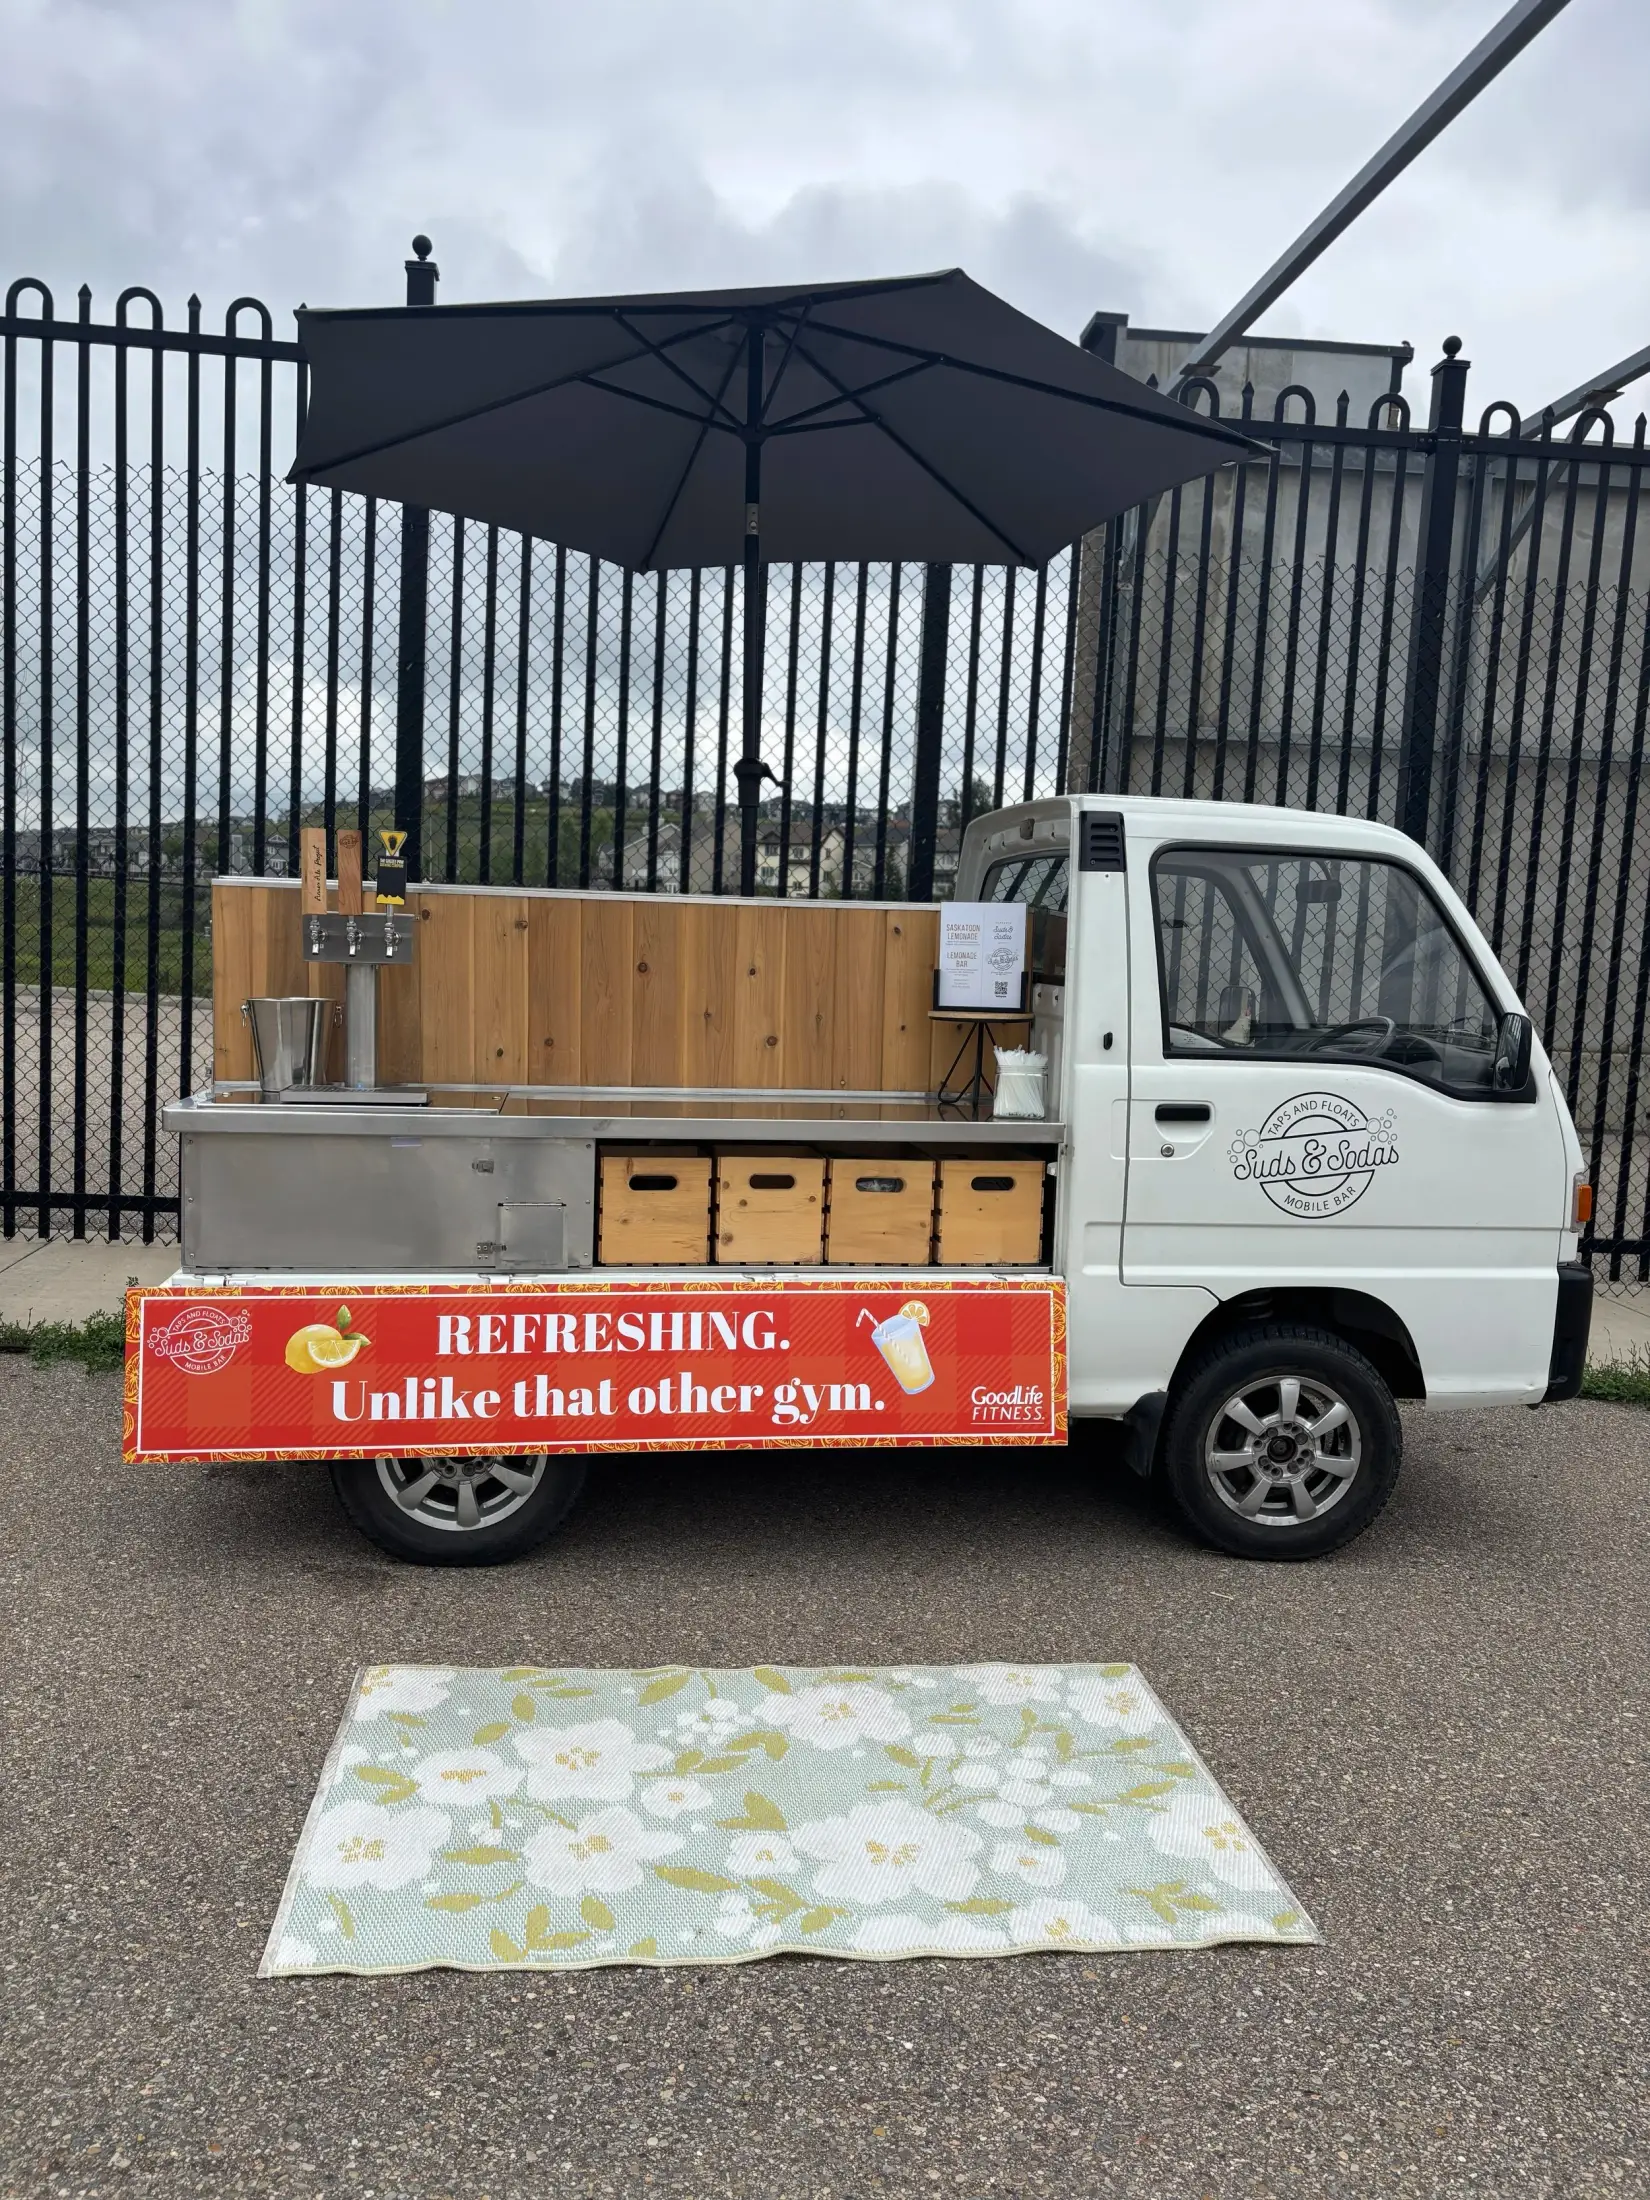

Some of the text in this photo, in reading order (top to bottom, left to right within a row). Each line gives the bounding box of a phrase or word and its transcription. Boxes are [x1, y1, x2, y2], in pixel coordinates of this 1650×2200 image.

[946, 924, 981, 932] SASKATOON
[947, 932, 978, 941] LEMONADE
[947, 951, 978, 960] LEMONADE
[956, 960, 968, 968] BAR
[1267, 1100, 1360, 1136] TAPS AND FLOATS
[1234, 1139, 1399, 1180] Suds & Sodas
[1283, 1186, 1356, 1211] MOBILE BAR
[172, 1310, 226, 1332] TAPS AND FLOATS
[154, 1330, 249, 1357] Suds & Sodas
[436, 1311, 790, 1355] REFRESHING.
[184, 1354, 226, 1371] MOBILE BAR
[331, 1372, 885, 1425] Unlike that other gym.
[971, 1385, 1044, 1405] GoodLife
